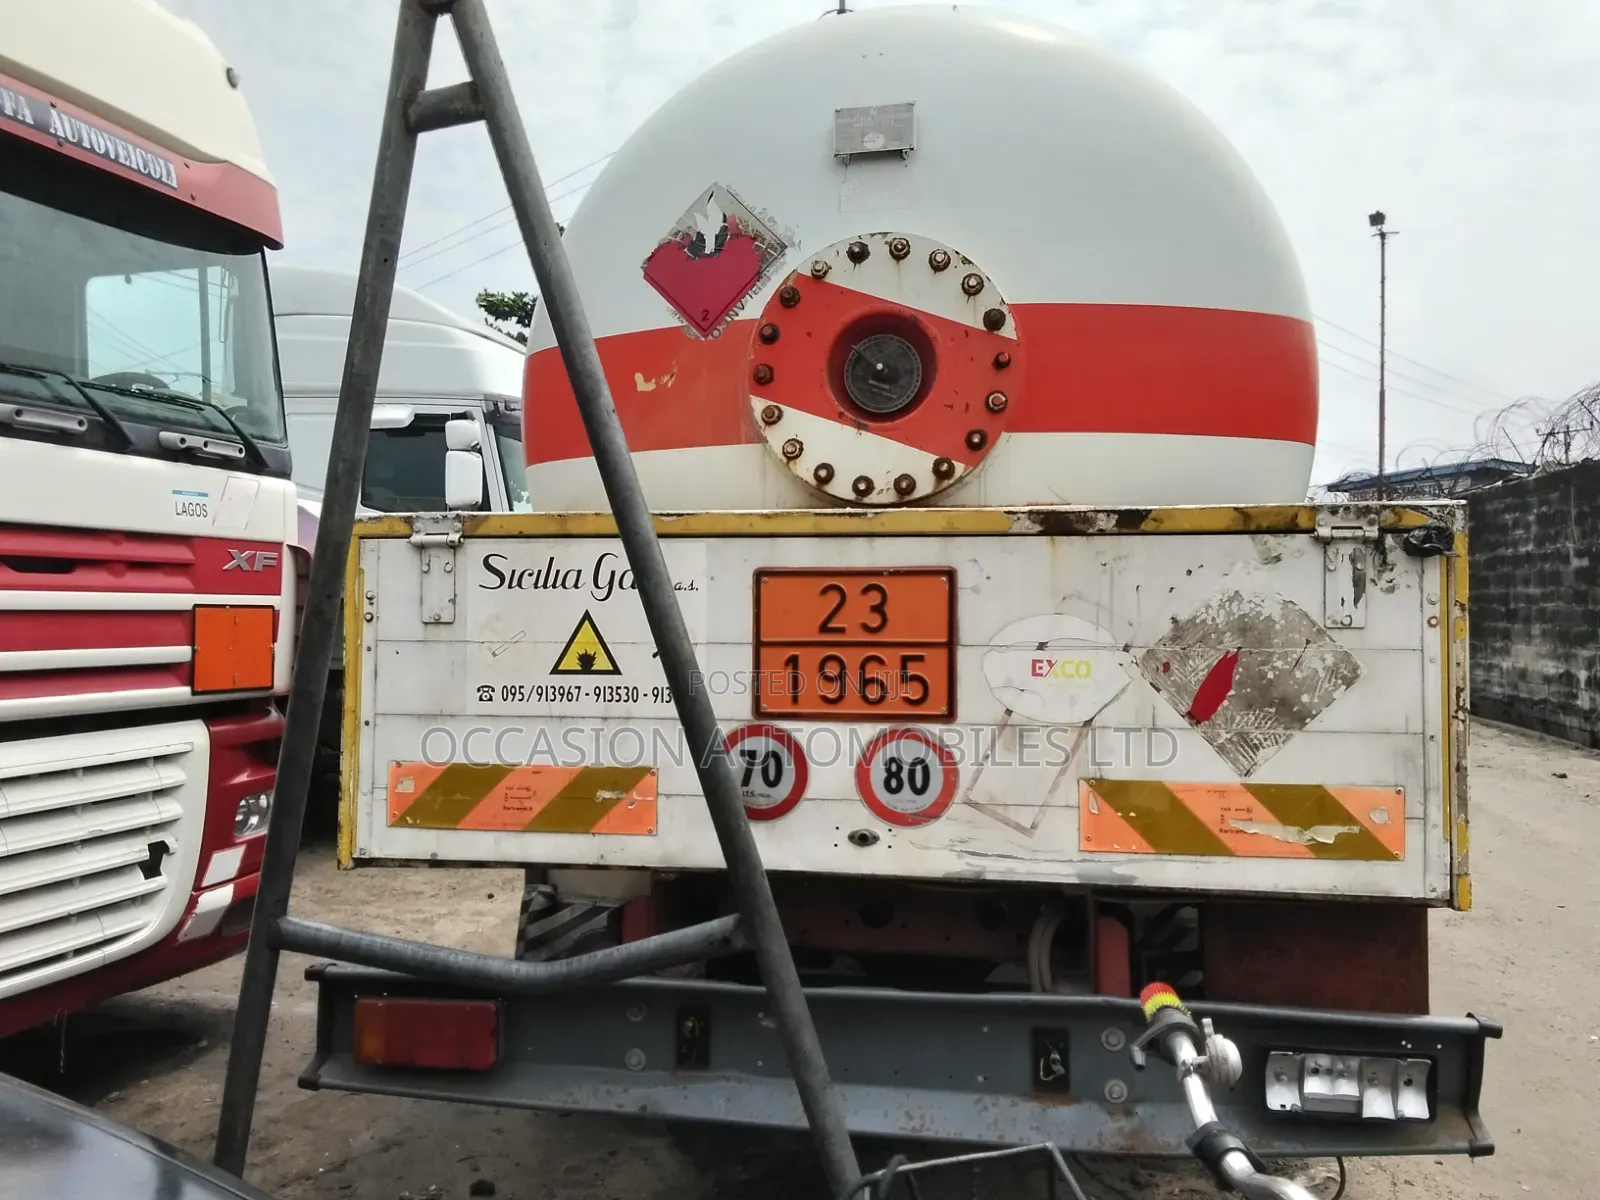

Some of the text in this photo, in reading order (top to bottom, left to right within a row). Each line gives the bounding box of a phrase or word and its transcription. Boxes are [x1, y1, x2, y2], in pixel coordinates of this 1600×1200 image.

[49, 108, 178, 189] AUTOVEICOLI
[701, 309, 710, 322] 2
[174, 501, 208, 518] LAGOS
[222, 548, 279, 572] XF
[478, 552, 587, 590] Sicilia
[590, 552, 638, 602] Ga
[818, 582, 889, 635] 23
[783, 652, 930, 706] 1965
[1031, 658, 1092, 679] EXCO
[501, 684, 582, 703] 095/913967
[593, 685, 639, 704] 913530
[652, 686, 673, 704] 913
[740, 749, 783, 789] 70
[883, 756, 931, 796] 80
